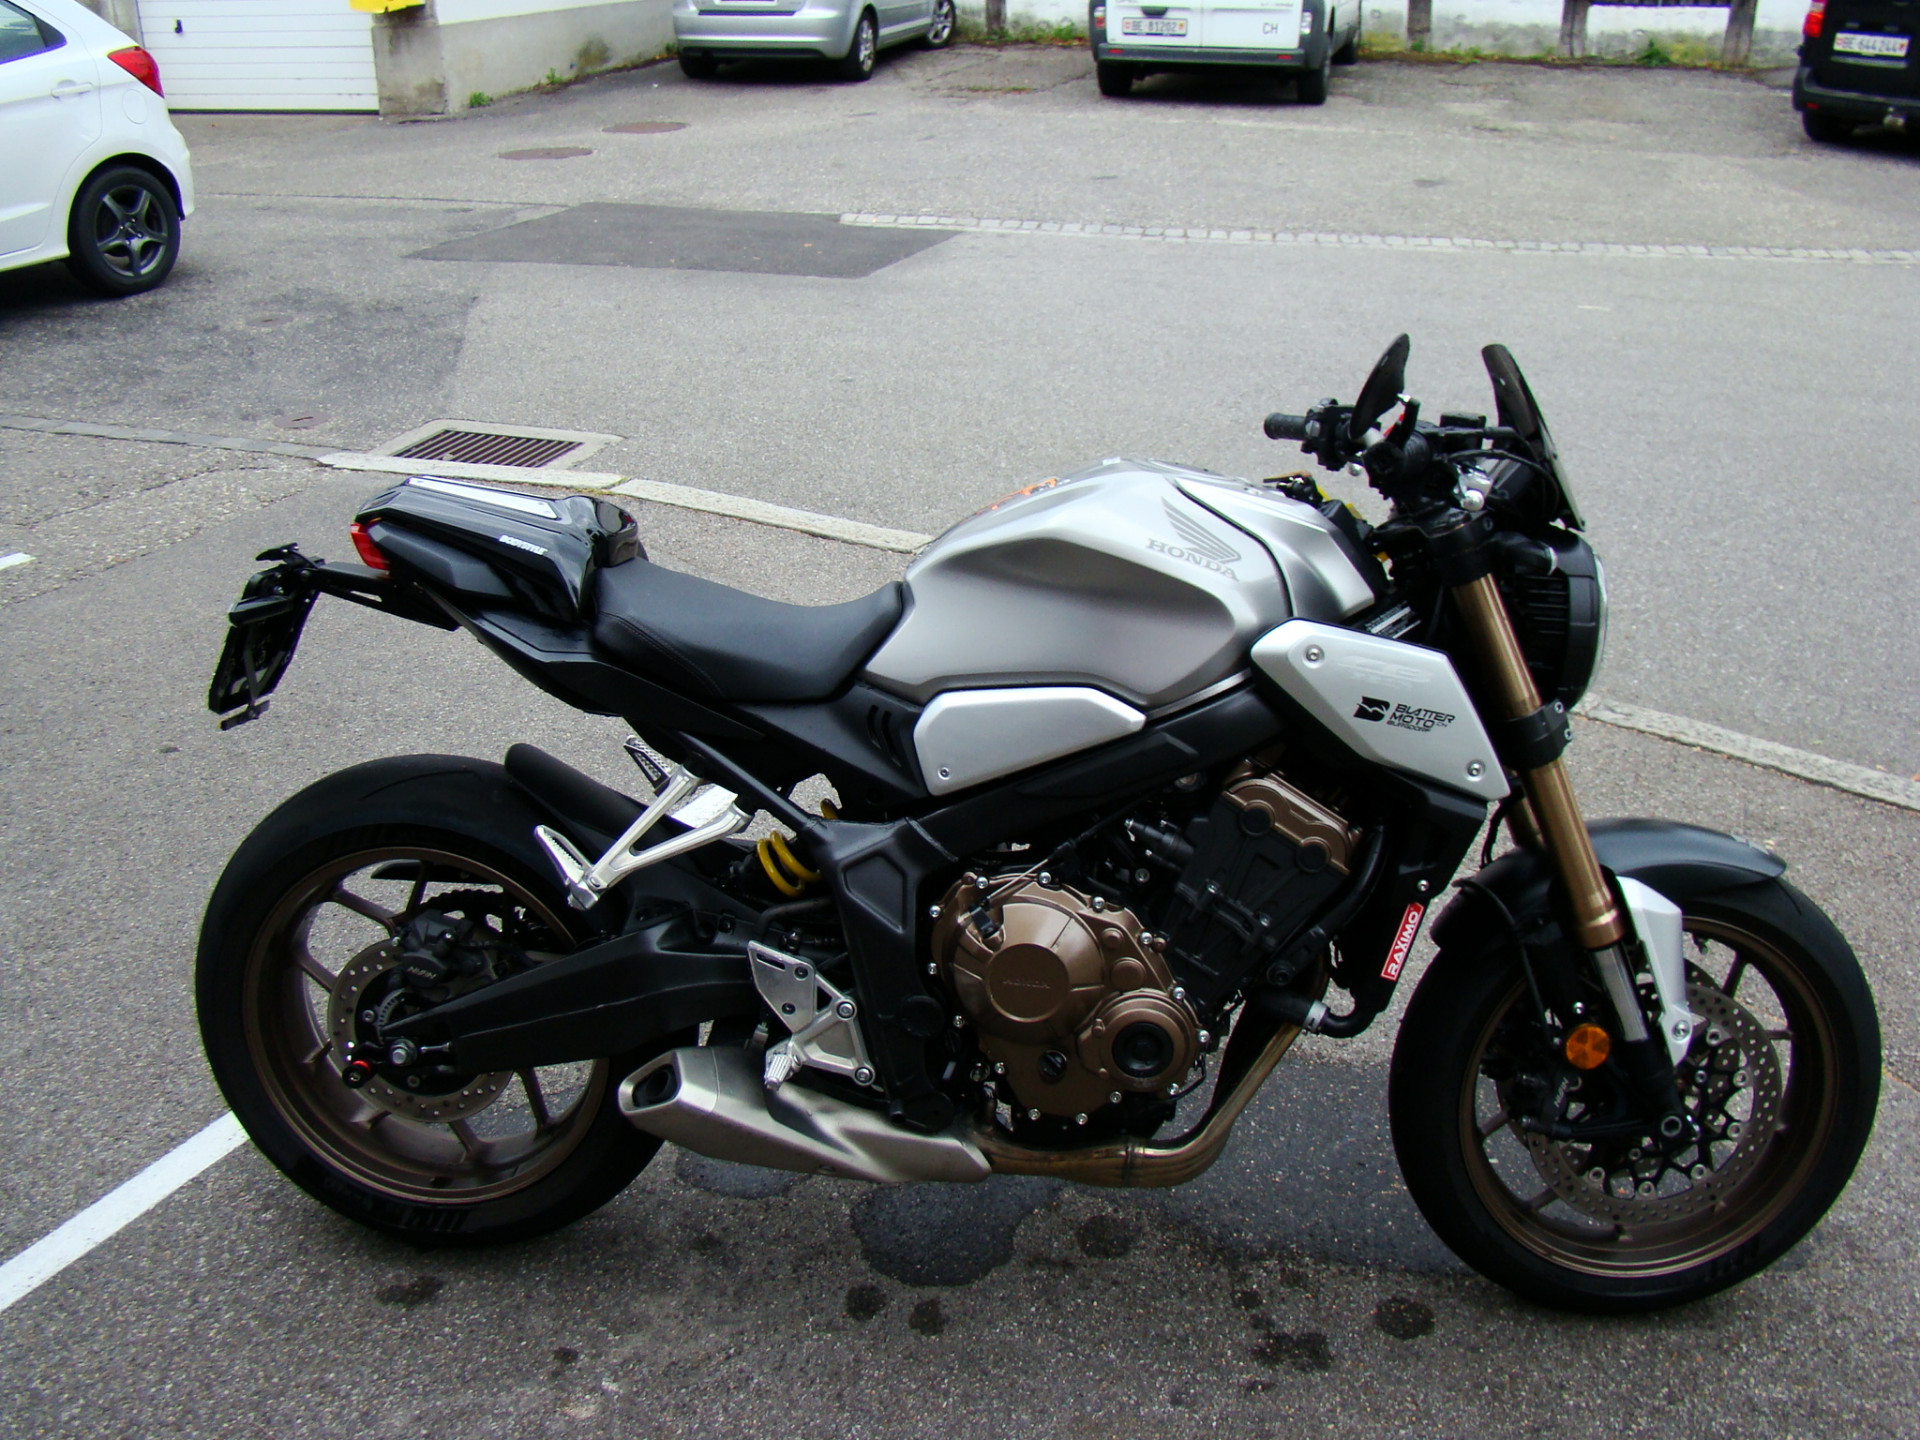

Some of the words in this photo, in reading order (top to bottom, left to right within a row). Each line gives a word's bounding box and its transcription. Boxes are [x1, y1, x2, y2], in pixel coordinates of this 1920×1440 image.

[1131, 20, 1144, 31] BE
[1262, 22, 1279, 35] CH
[1146, 538, 1240, 582] HONDA
[1389, 711, 1435, 729] MOTO
[1394, 703, 1456, 724] BLATTER
[1387, 910, 1419, 976] RAXIMO
